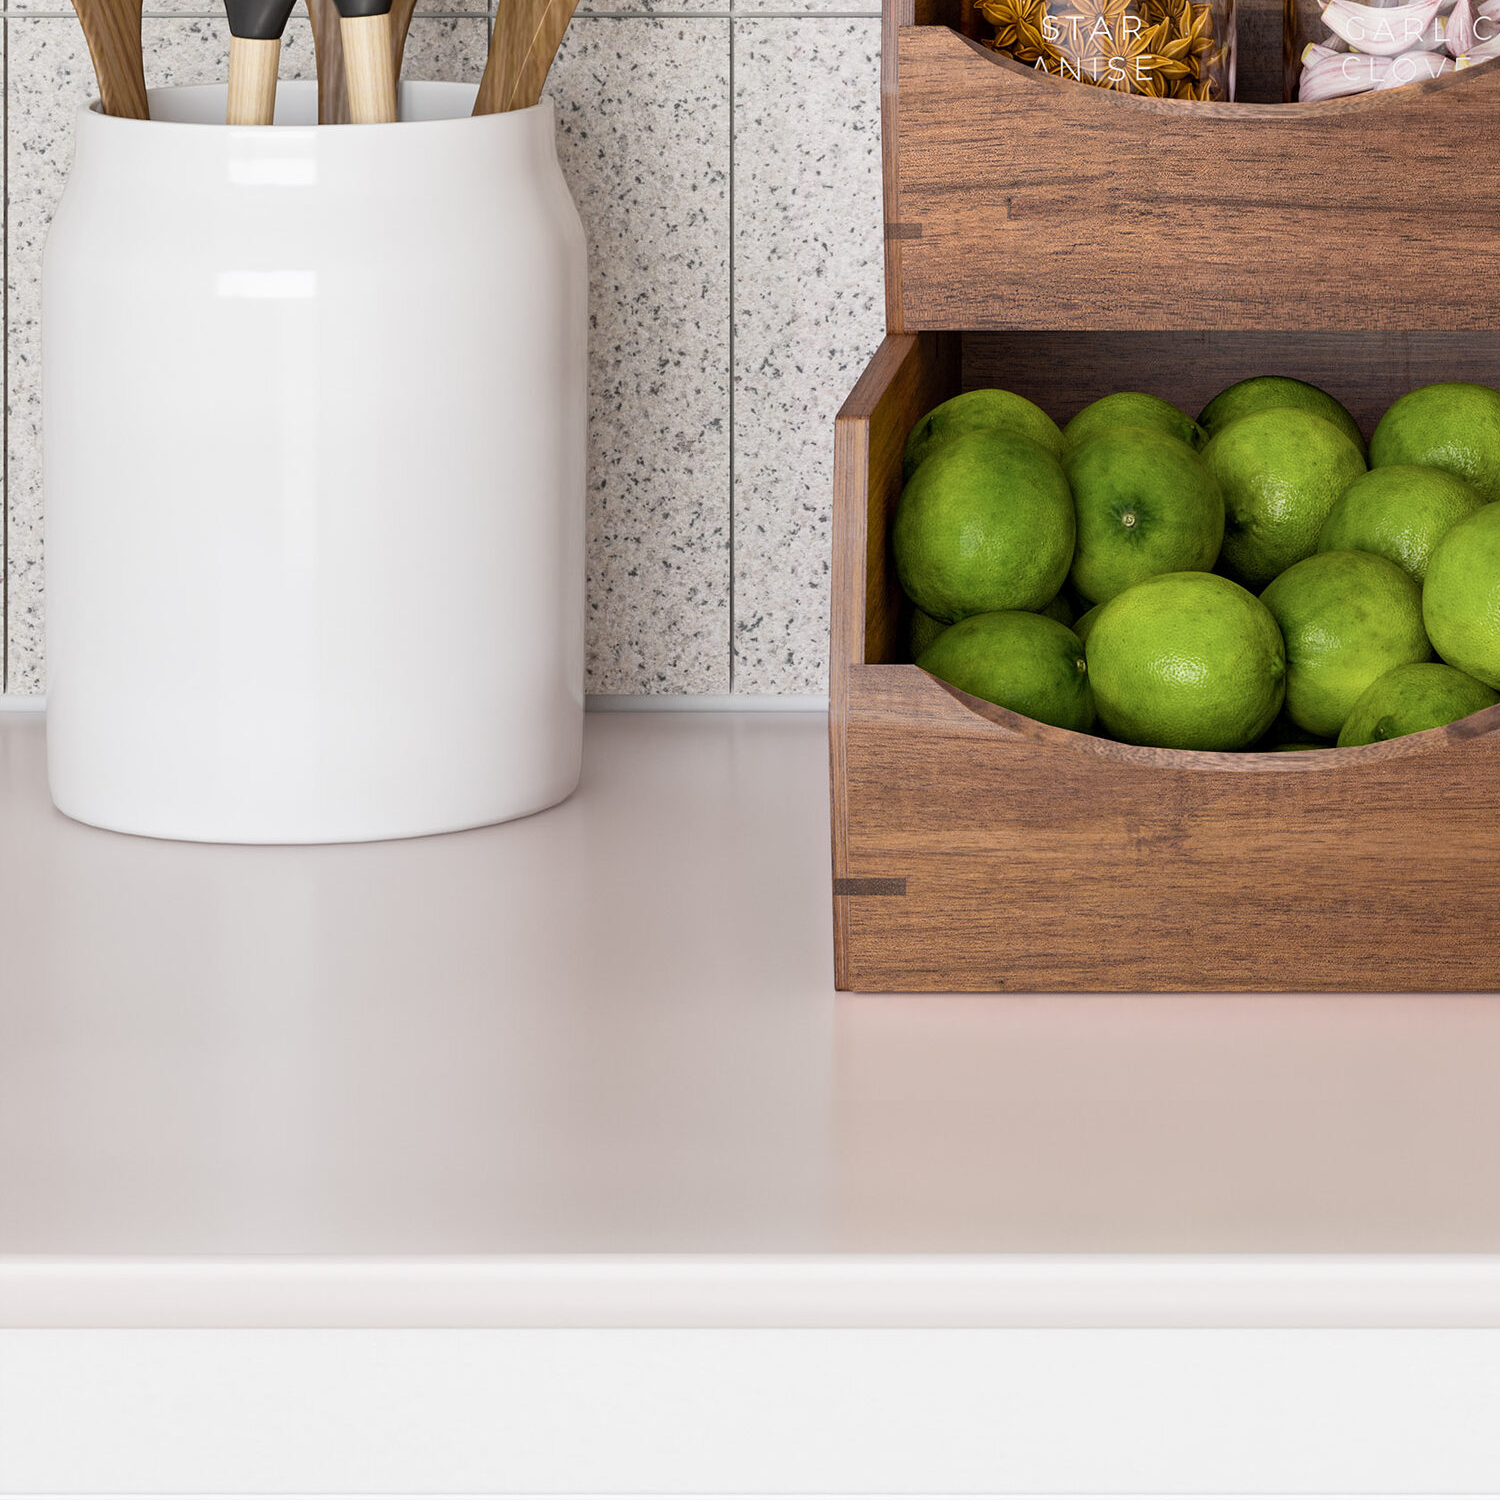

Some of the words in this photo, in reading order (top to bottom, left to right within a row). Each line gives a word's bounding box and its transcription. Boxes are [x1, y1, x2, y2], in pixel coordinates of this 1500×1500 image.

[1042, 15, 1143, 41] STAR
[1345, 16, 1493, 42] GARLIC
[1342, 56, 1494, 83] CLOVE
